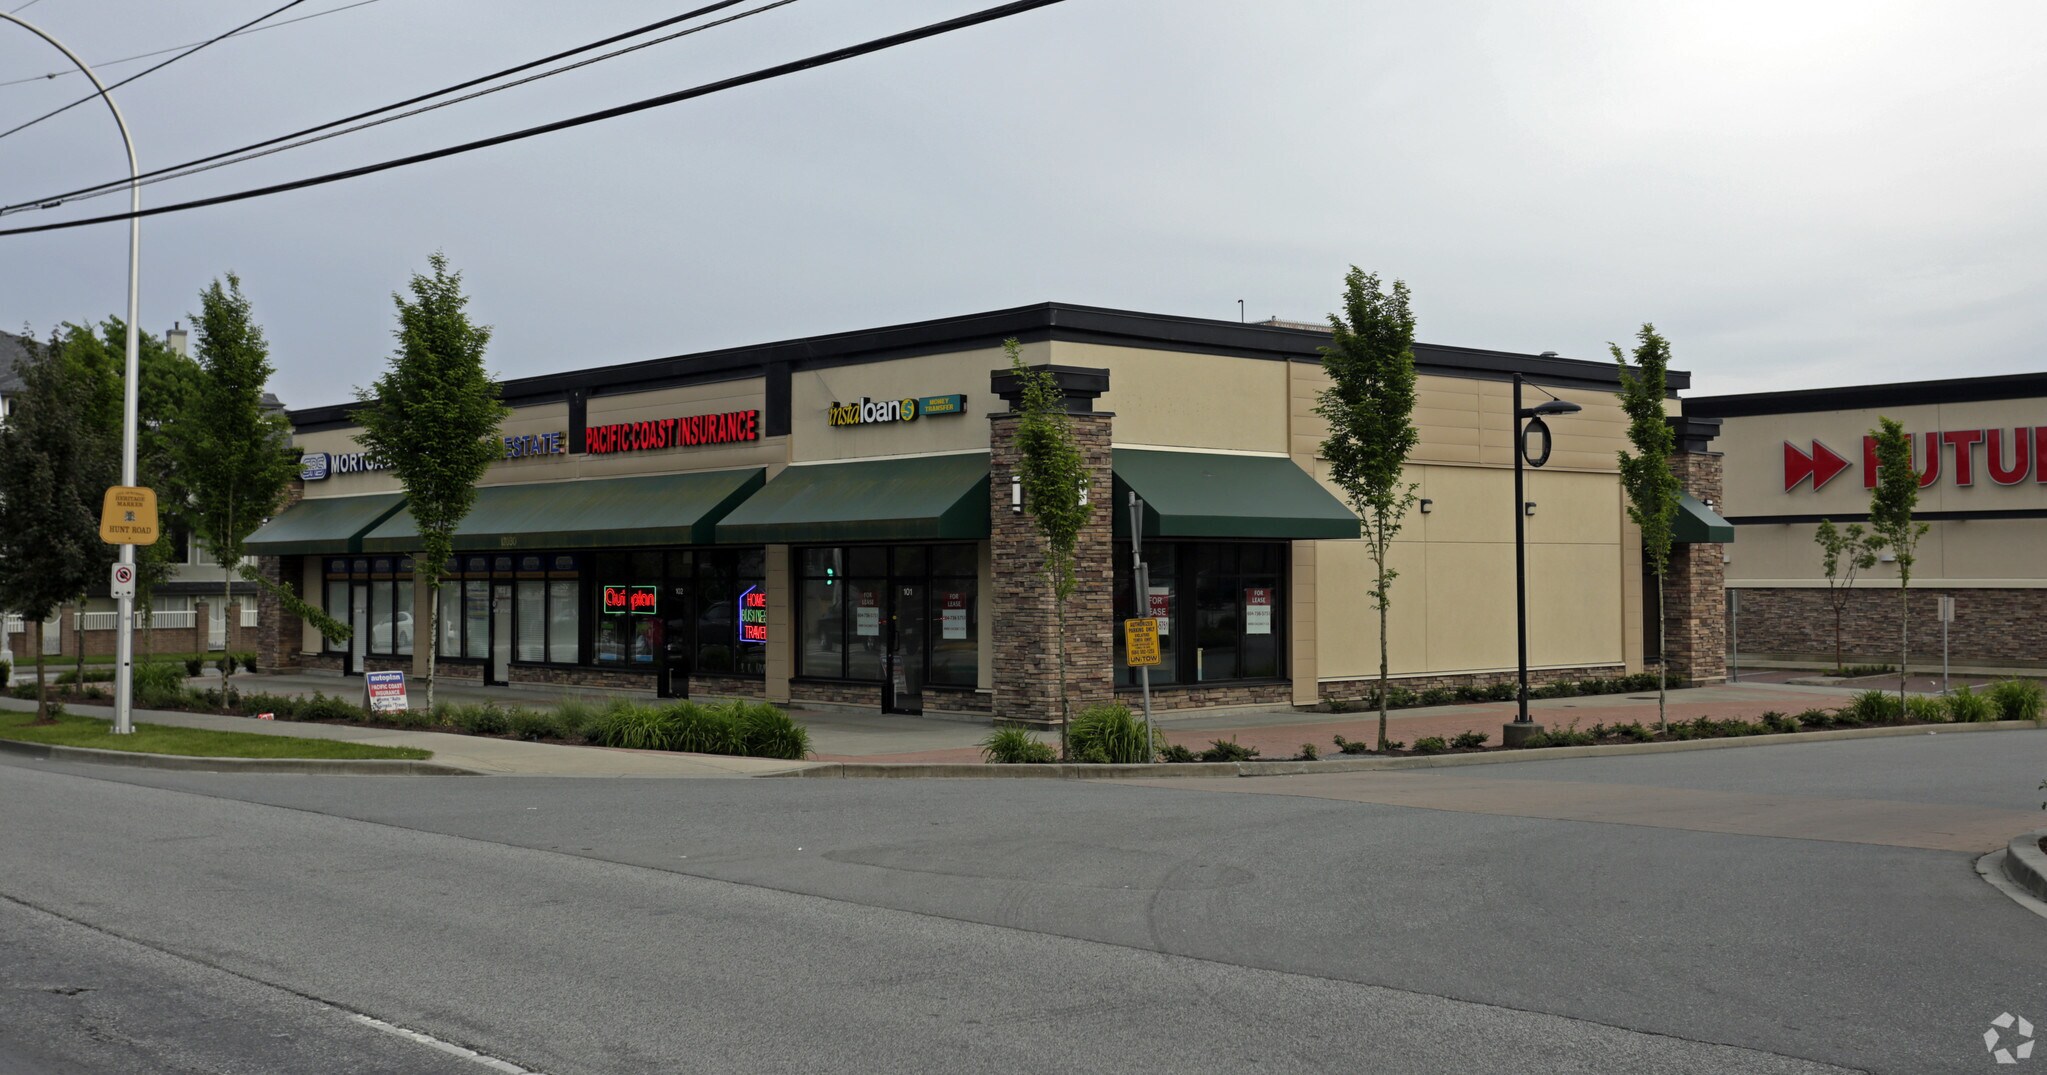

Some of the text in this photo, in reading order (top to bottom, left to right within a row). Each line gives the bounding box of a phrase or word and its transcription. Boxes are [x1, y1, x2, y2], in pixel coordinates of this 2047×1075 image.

[925, 403, 954, 413] TRANSFER
[586, 409, 757, 456] PACIFIC COAST INSURANCE
[1863, 426, 2047, 488] FUTU
[331, 452, 397, 474] MORTGA
[109, 525, 152, 534] HUNT ROAD
[903, 588, 913, 596] 101
[746, 593, 766, 607] HOME
[1150, 607, 1166, 616] EASE
[371, 674, 400, 682] autoplan
